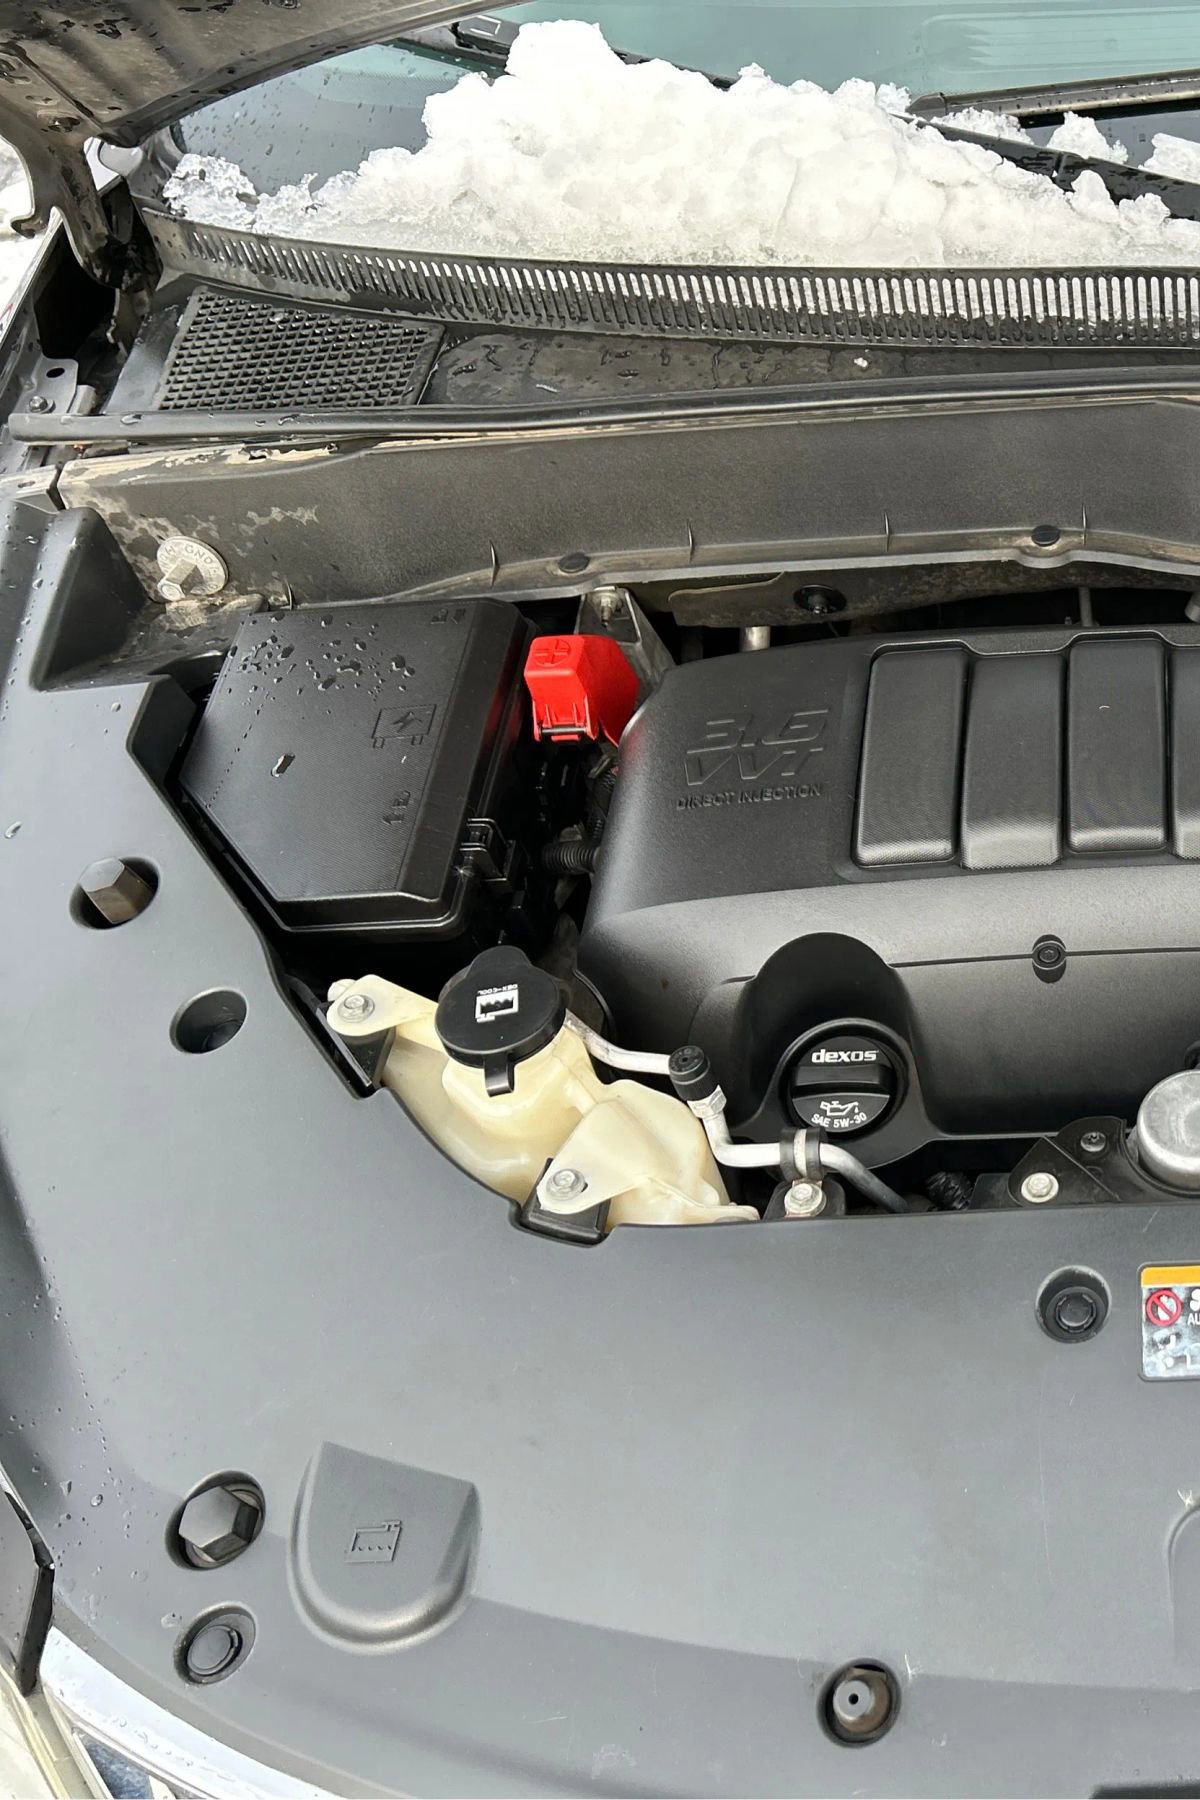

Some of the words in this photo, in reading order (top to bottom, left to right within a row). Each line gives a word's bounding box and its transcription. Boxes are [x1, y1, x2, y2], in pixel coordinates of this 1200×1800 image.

[676, 791, 735, 811] DIRECT
[738, 784, 823, 804] INJECTION
[811, 1048, 879, 1063] dexos
[811, 1113, 831, 1128] SAE
[833, 1112, 867, 1128] 5W-30
